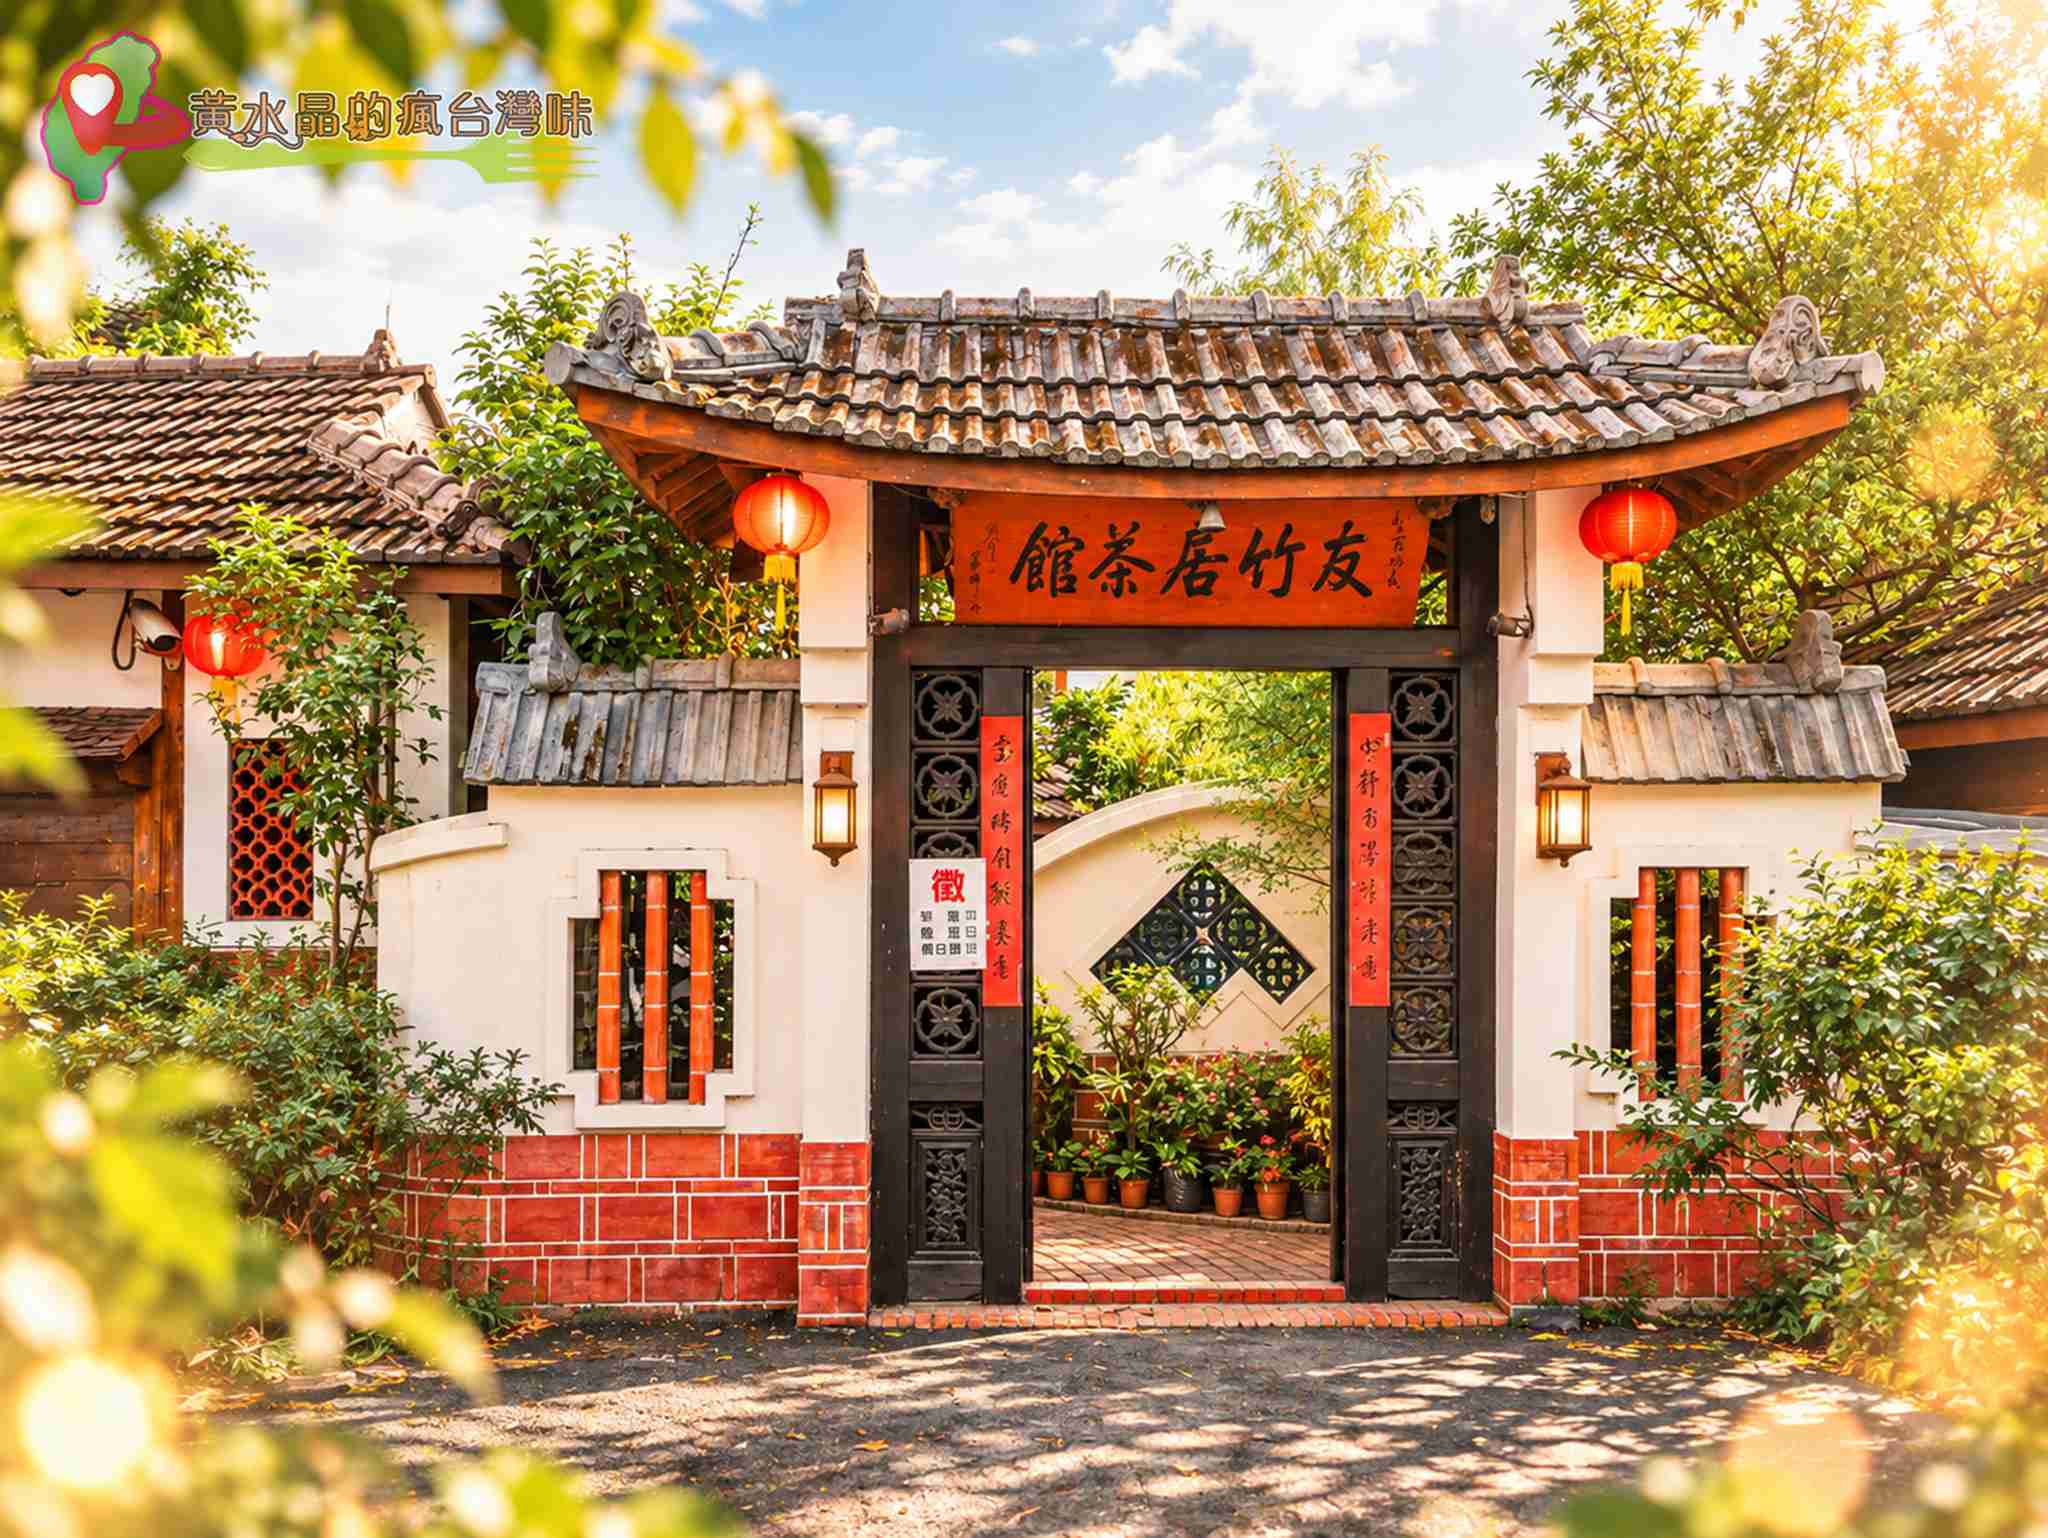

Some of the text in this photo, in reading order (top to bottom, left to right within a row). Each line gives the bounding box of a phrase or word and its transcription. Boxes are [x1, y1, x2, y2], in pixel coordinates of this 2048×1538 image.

[1008, 520, 1374, 598] 友竹居茶館
